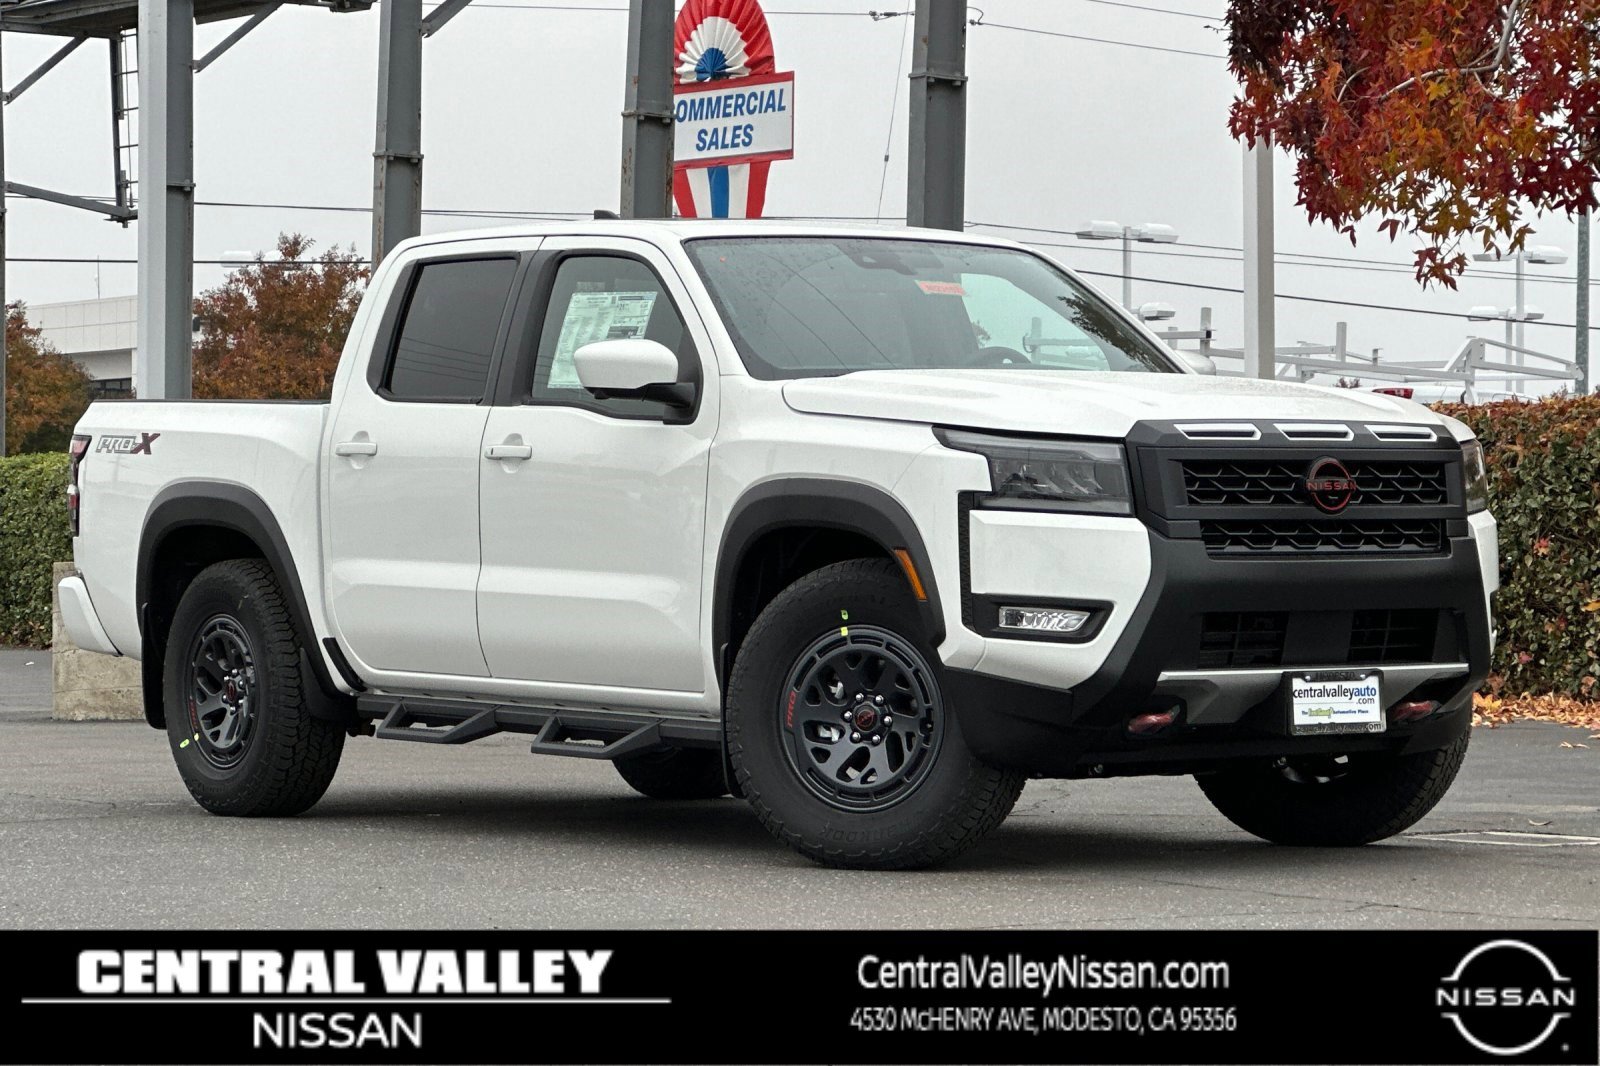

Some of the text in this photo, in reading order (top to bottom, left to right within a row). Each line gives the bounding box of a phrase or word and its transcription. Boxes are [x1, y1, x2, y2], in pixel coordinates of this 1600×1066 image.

[674, 88, 786, 122] OMMERCIAL
[696, 124, 754, 151] SALES
[1307, 480, 1357, 491] NISSAN
[1293, 685, 1377, 700] centralvalleyauto
[1355, 697, 1375, 705] .com
